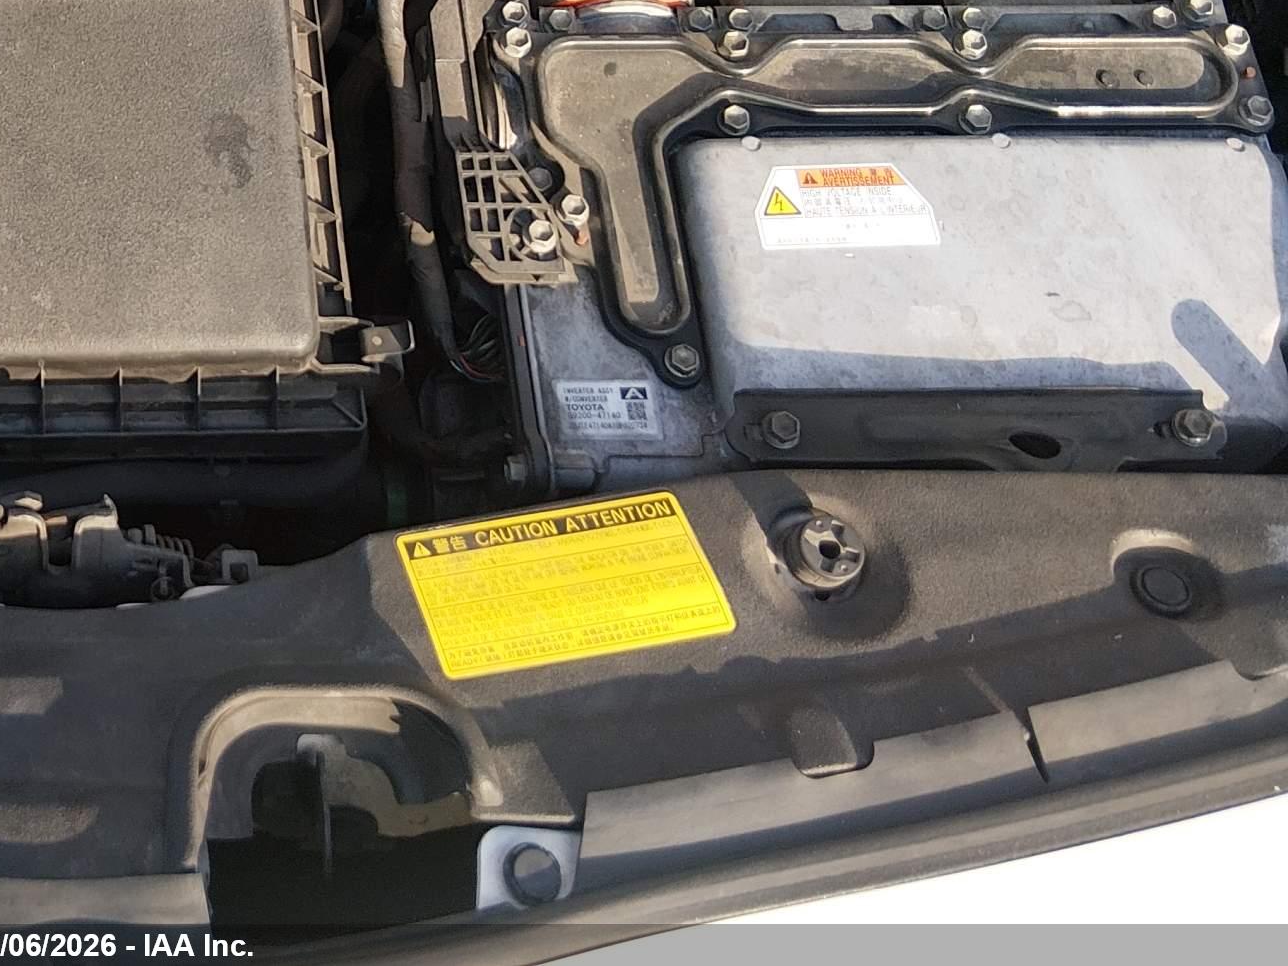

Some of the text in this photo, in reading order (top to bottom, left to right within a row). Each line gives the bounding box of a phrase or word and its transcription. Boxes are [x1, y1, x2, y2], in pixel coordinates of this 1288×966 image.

[821, 168, 862, 178] WARNING
[823, 175, 896, 186] AVERTISSEMENT
[566, 403, 605, 412] TOYOTA
[432, 535, 468, 554] 警告
[475, 519, 559, 547] CAUTION
[565, 500, 672, 533] ATTENTION
